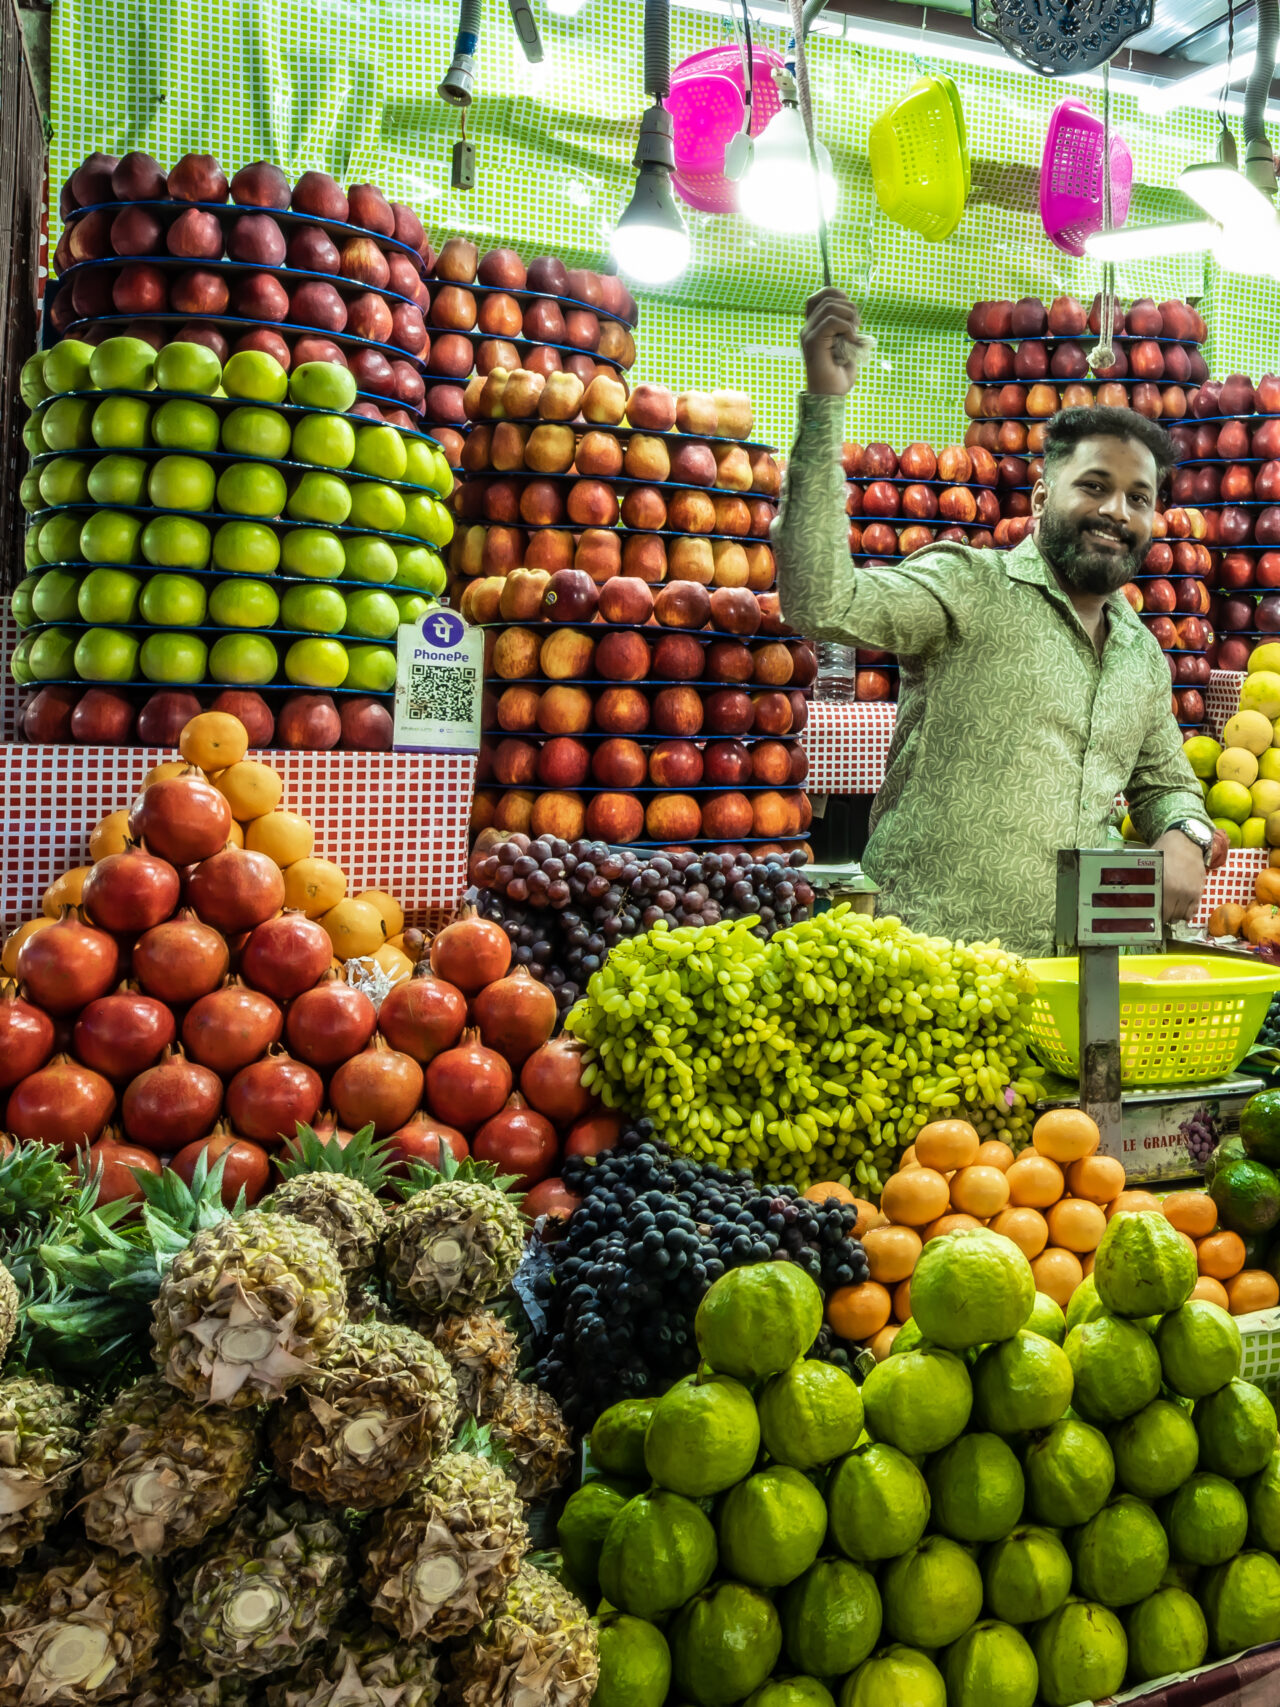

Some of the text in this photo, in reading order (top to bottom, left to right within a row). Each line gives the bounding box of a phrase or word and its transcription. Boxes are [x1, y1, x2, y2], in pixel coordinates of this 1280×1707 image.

[432, 616, 454, 643] पे
[414, 648, 469, 662] PhonePe
[1123, 1133, 1189, 1152] LE GRAPES
